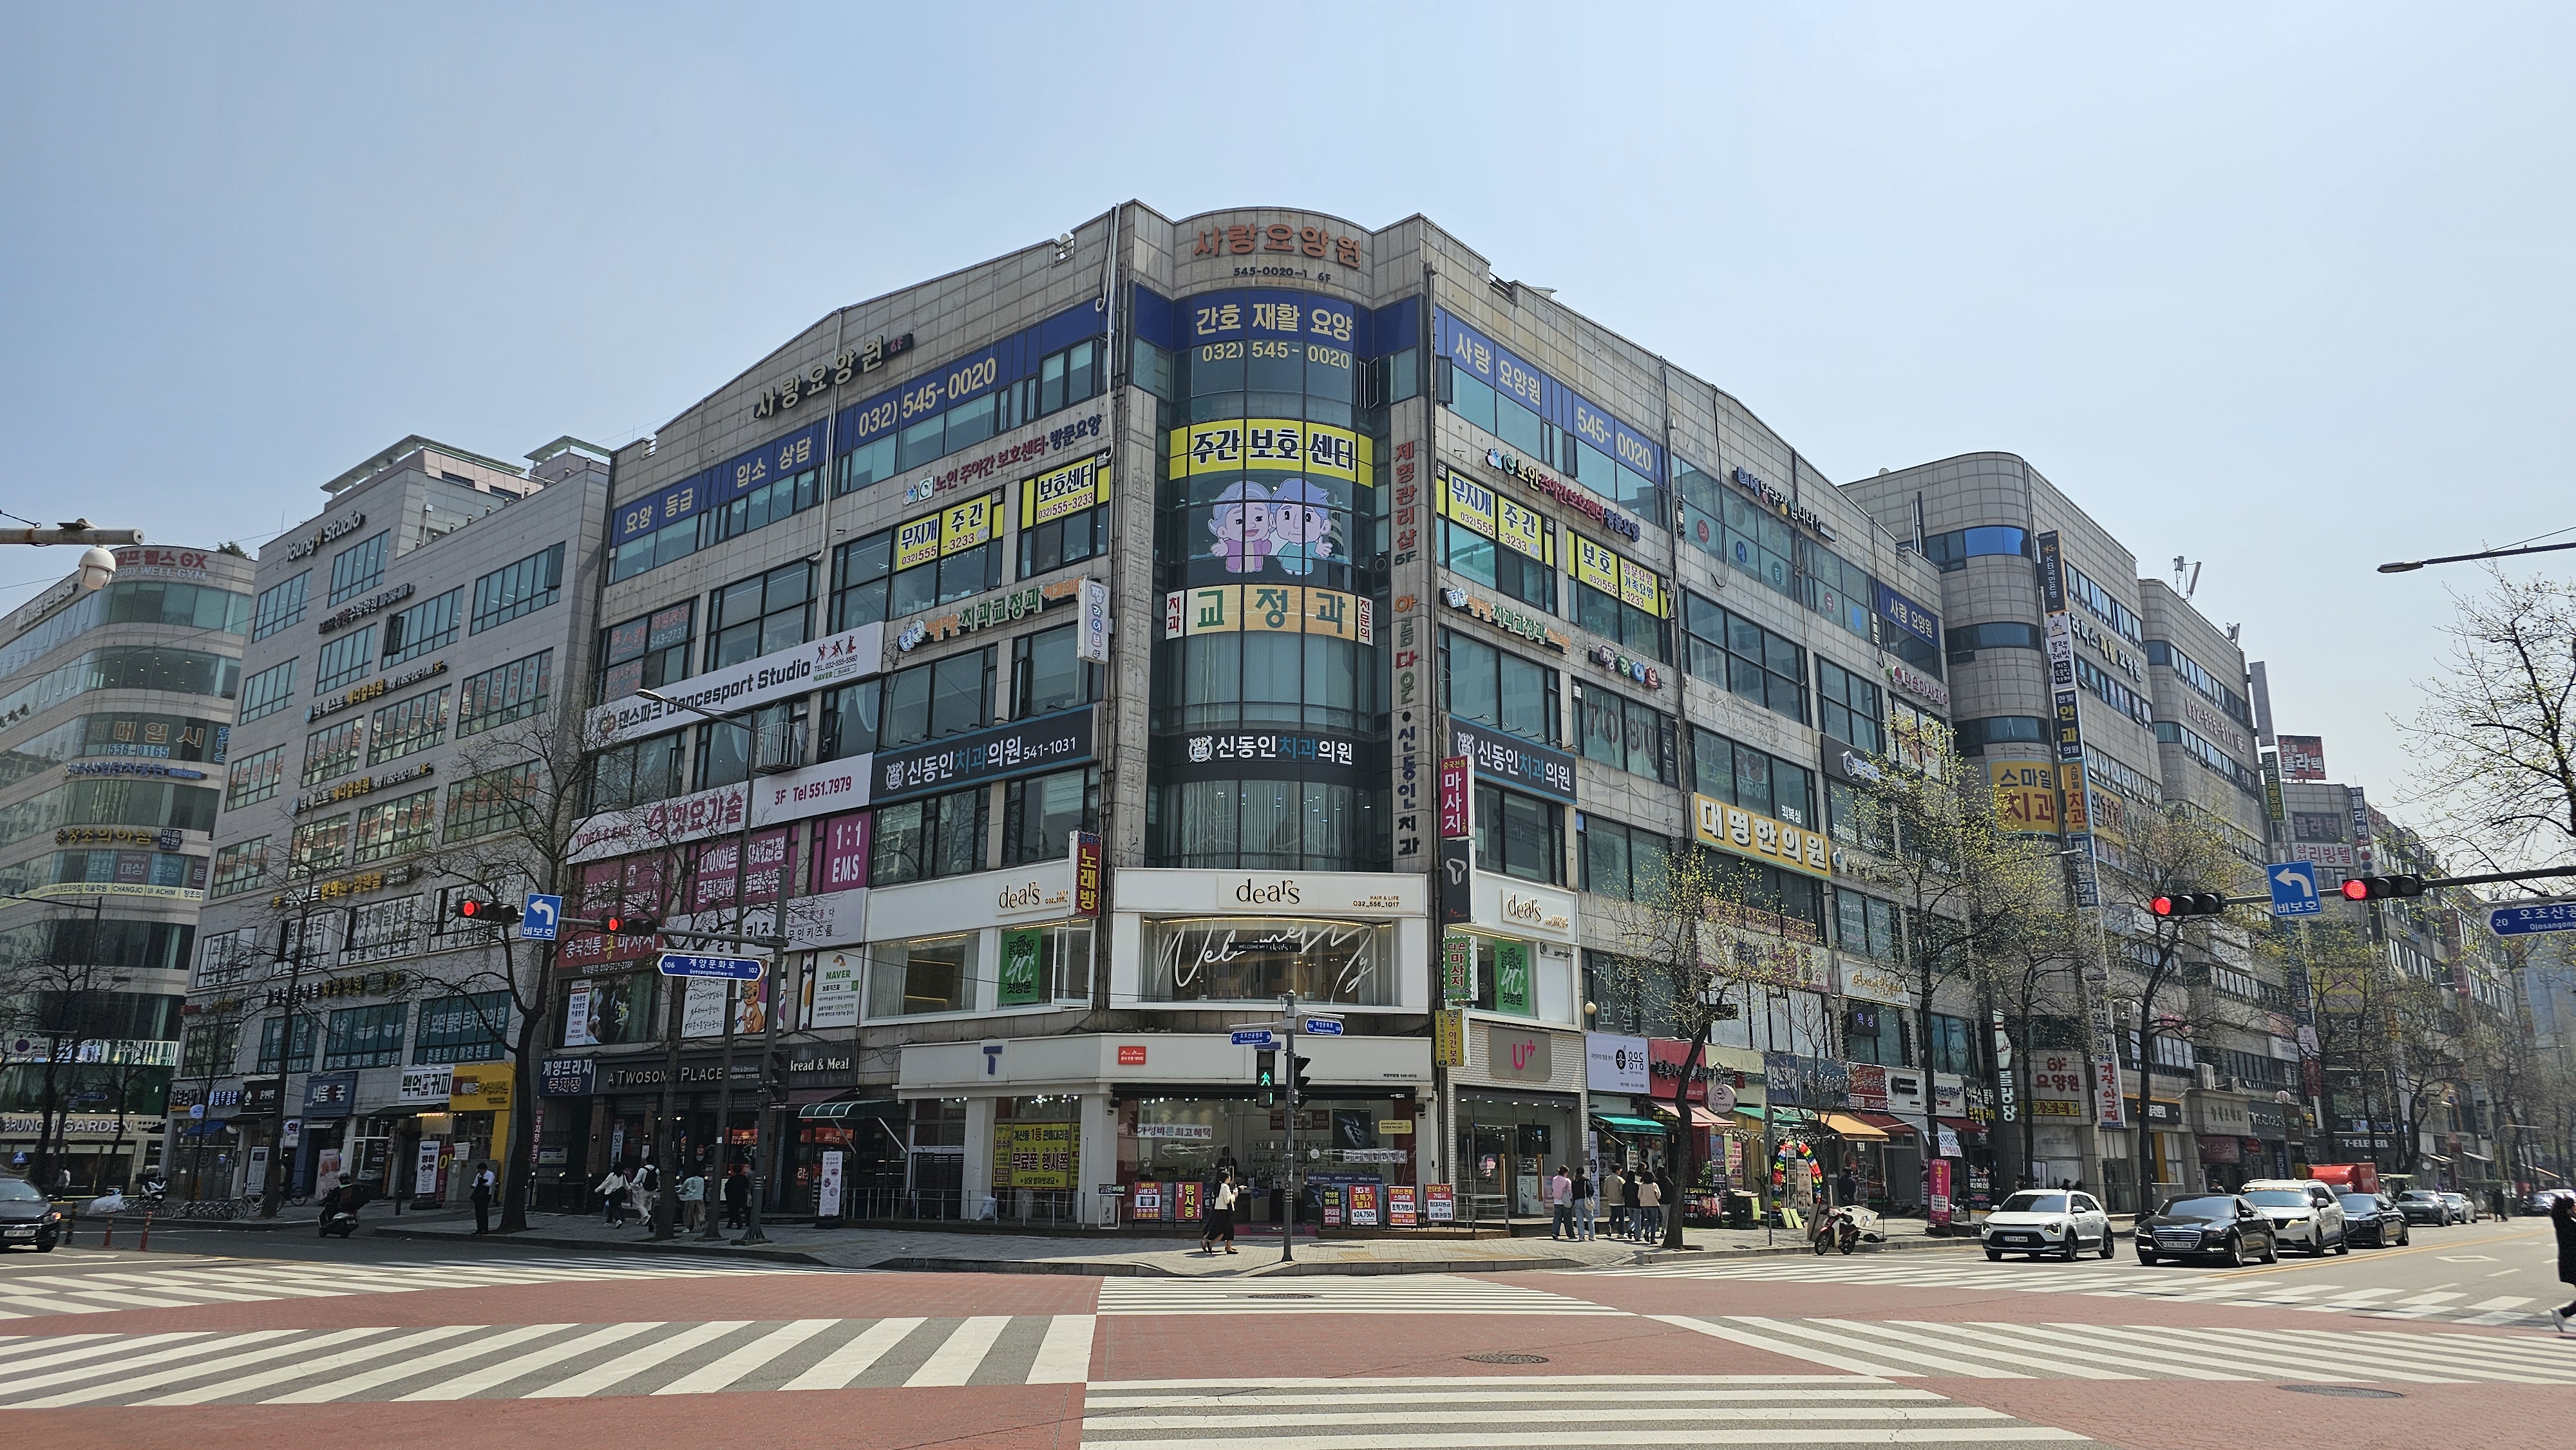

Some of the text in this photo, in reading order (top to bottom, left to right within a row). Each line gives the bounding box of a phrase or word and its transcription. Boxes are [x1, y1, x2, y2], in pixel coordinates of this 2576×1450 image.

[1194, 223, 1361, 268] 사랑요양원
[1318, 272, 1331, 282] 6F
[1197, 303, 1352, 341] 간호 재활 요양
[1202, 343, 1244, 362] 032)
[1308, 346, 1350, 369] 0020
[1455, 333, 1541, 407] 사랑 요양원
[756, 334, 904, 418] 사랑요양원 6F
[859, 402, 896, 437] 032)
[948, 358, 996, 400] 0020
[935, 414, 1102, 491] 노인 주야간 보호센터 방문요양
[1193, 429, 1354, 469] 주간 보호 센터
[1617, 430, 1651, 472] 0020
[625, 438, 811, 534] 요양 등급 입소 상담
[1039, 464, 1094, 503] 보호센터
[1517, 459, 1539, 491] 노인
[1038, 493, 1092, 520] 032)555-3233
[1452, 476, 1492, 517] 무지개
[323, 511, 362, 543] Studio
[902, 519, 937, 552] 무지개
[144, 551, 175, 566] 헬스
[180, 553, 209, 569] GX
[1394, 551, 1417, 565] 5F
[140, 567, 173, 577] WELL
[177, 569, 206, 579] GYM
[1623, 561, 1653, 585] 방문요양
[1624, 578, 1653, 599] 가족요양
[961, 588, 1043, 632] 치과교정과
[1090, 584, 1104, 647] 짱라이브
[1168, 596, 1181, 634] 치과
[1197, 589, 1346, 636] 교정과
[1359, 599, 1370, 642] 전문의
[1492, 603, 1544, 645] 치과교정과
[1890, 598, 1933, 639] 사랑 요양원
[650, 626, 687, 648] 543-2737
[2051, 641, 2067, 652] 블랙
[2070, 613, 2097, 648] 라미스
[2118, 650, 2141, 683] 요양원
[757, 660, 810, 689] Studio
[813, 671, 832, 682] NAVER
[2058, 695, 2074, 703] 한빛
[2060, 706, 2078, 742] 안과
[109, 744, 169, 757] 556-0165
[907, 737, 1075, 785] 신동인치과의원 541-1031
[1216, 735, 1352, 764] 신동인치과의원
[2063, 746, 2079, 754] 의원
[2282, 753, 2324, 773] 콜라텍
[1478, 740, 1570, 791] 신동인치과의원
[2000, 769, 2052, 789] 스마일
[2070, 766, 2079, 788] 스마일
[775, 776, 851, 805] 3F Tel 551.7979
[1444, 771, 1461, 833] 마사지
[1781, 805, 1801, 824] 킥복싱
[2004, 793, 2055, 824] 치과
[2069, 793, 2086, 824] 치과
[2351, 796, 2368, 838] 콜라텍
[69, 828, 152, 845] 창조의아침
[162, 838, 180, 847] 학원
[1700, 800, 1827, 871] 대명한의원
[833, 854, 858, 882] EMS
[2308, 845, 2351, 864] 리빙텔
[119, 863, 145, 875] 대상
[1080, 849, 1096, 909] 노래방
[2277, 901, 2317, 913] 비보호
[523, 927, 553, 937] 비보호
[566, 939, 601, 959] 중국전통
[1448, 942, 1466, 951] 다은
[688, 958, 735, 969] 계양문화로
[826, 970, 851, 980] NAVER
[1450, 954, 1464, 986] 마사지
[1007, 983, 1031, 994] 첫방문
[1503, 993, 1522, 1005] 첫방문
[543, 1059, 592, 1077] 계양프라자
[1512, 1039, 1535, 1070] U+
[549, 1077, 582, 1093] 주차장
[607, 1073, 614, 1084] A
[681, 1067, 723, 1082] PLACE
[2036, 1075, 2079, 1091] 요양원
[1014, 1130, 1029, 1140] 계산동
[1032, 1128, 1042, 1141] 1등
[1012, 1153, 1038, 1171] 무료폰
[1042, 1153, 1068, 1171] 행사폰
[1184, 1184, 1195, 1217] 행사중
